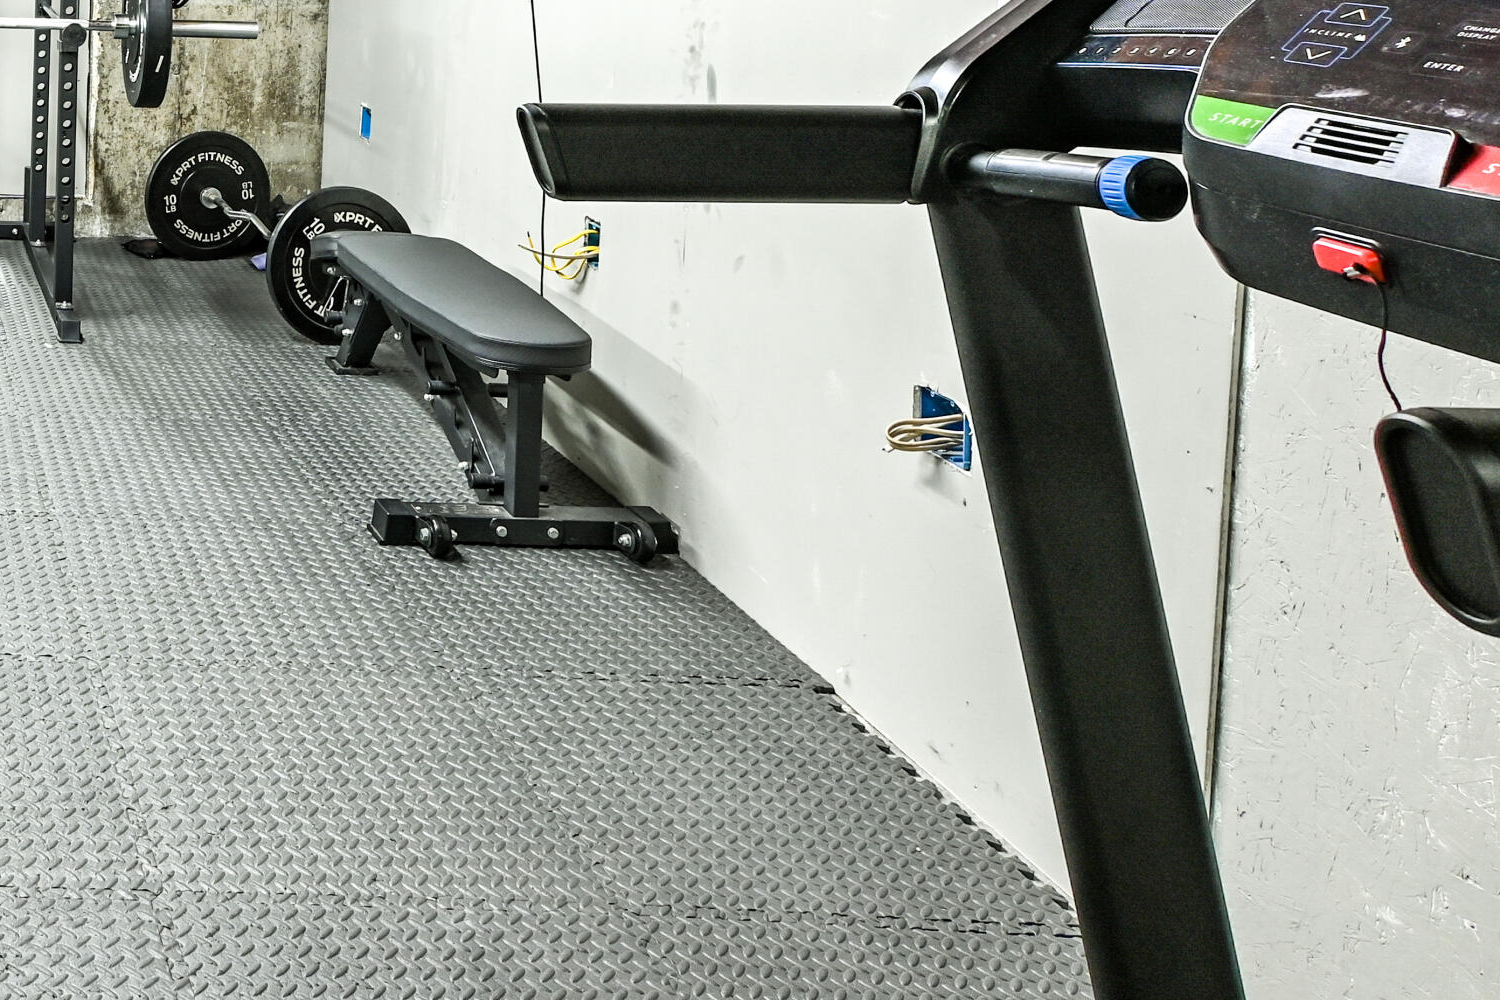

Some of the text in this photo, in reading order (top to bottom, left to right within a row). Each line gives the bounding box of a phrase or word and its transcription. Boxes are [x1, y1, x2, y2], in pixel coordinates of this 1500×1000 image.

[1303, 27, 1353, 39] INCLINE
[1457, 31, 1497, 40] DISPLAY
[1423, 61, 1465, 73] ENTER
[1208, 112, 1264, 129] START
[170, 152, 244, 186] XPRT FITNESS
[241, 181, 253, 189] LB
[163, 194, 177, 205] 10
[241, 189, 254, 200] 10
[165, 205, 176, 213] LB
[310, 217, 325, 235] 10
[333, 211, 374, 229] XPRT
[173, 219, 243, 242] PRT FITNESS
[302, 225, 315, 240] LB
[292, 247, 317, 309] FITNESS
